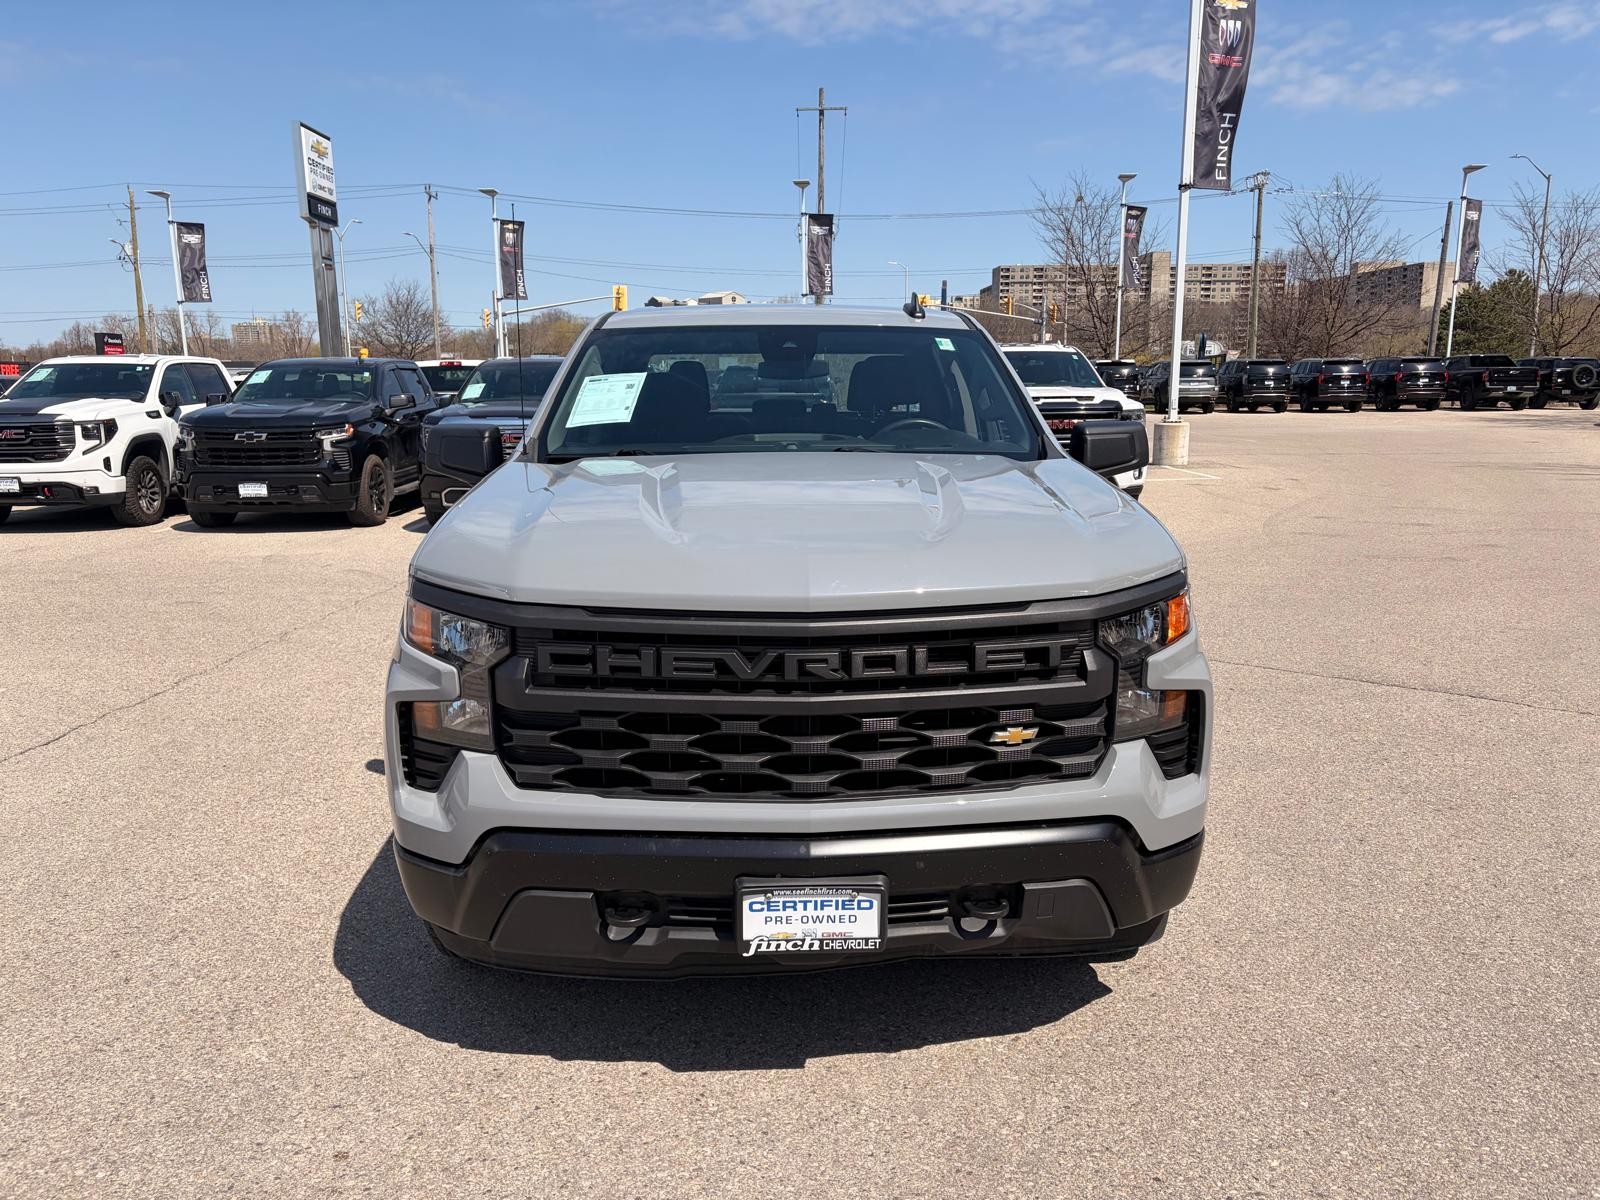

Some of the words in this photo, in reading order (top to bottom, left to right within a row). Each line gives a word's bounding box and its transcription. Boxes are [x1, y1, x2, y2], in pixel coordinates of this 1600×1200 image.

[1208, 53, 1243, 68] GMC
[1215, 112, 1236, 180] FINCH
[307, 157, 334, 175] CERTIFIED
[317, 203, 332, 217] FINCH
[200, 271, 210, 299] FINCH
[516, 269, 526, 297] FINCH
[824, 263, 832, 292] FINCH
[0, 364, 20, 377] FREE
[537, 636, 1080, 681] CHEVROLET
[773, 888, 853, 896] www.seefinchfirst.com
[748, 899, 874, 913] CERTIFIED
[765, 914, 858, 925] PRE-OWNED
[742, 935, 821, 957] finch
[823, 938, 882, 951] CHEVROLET
